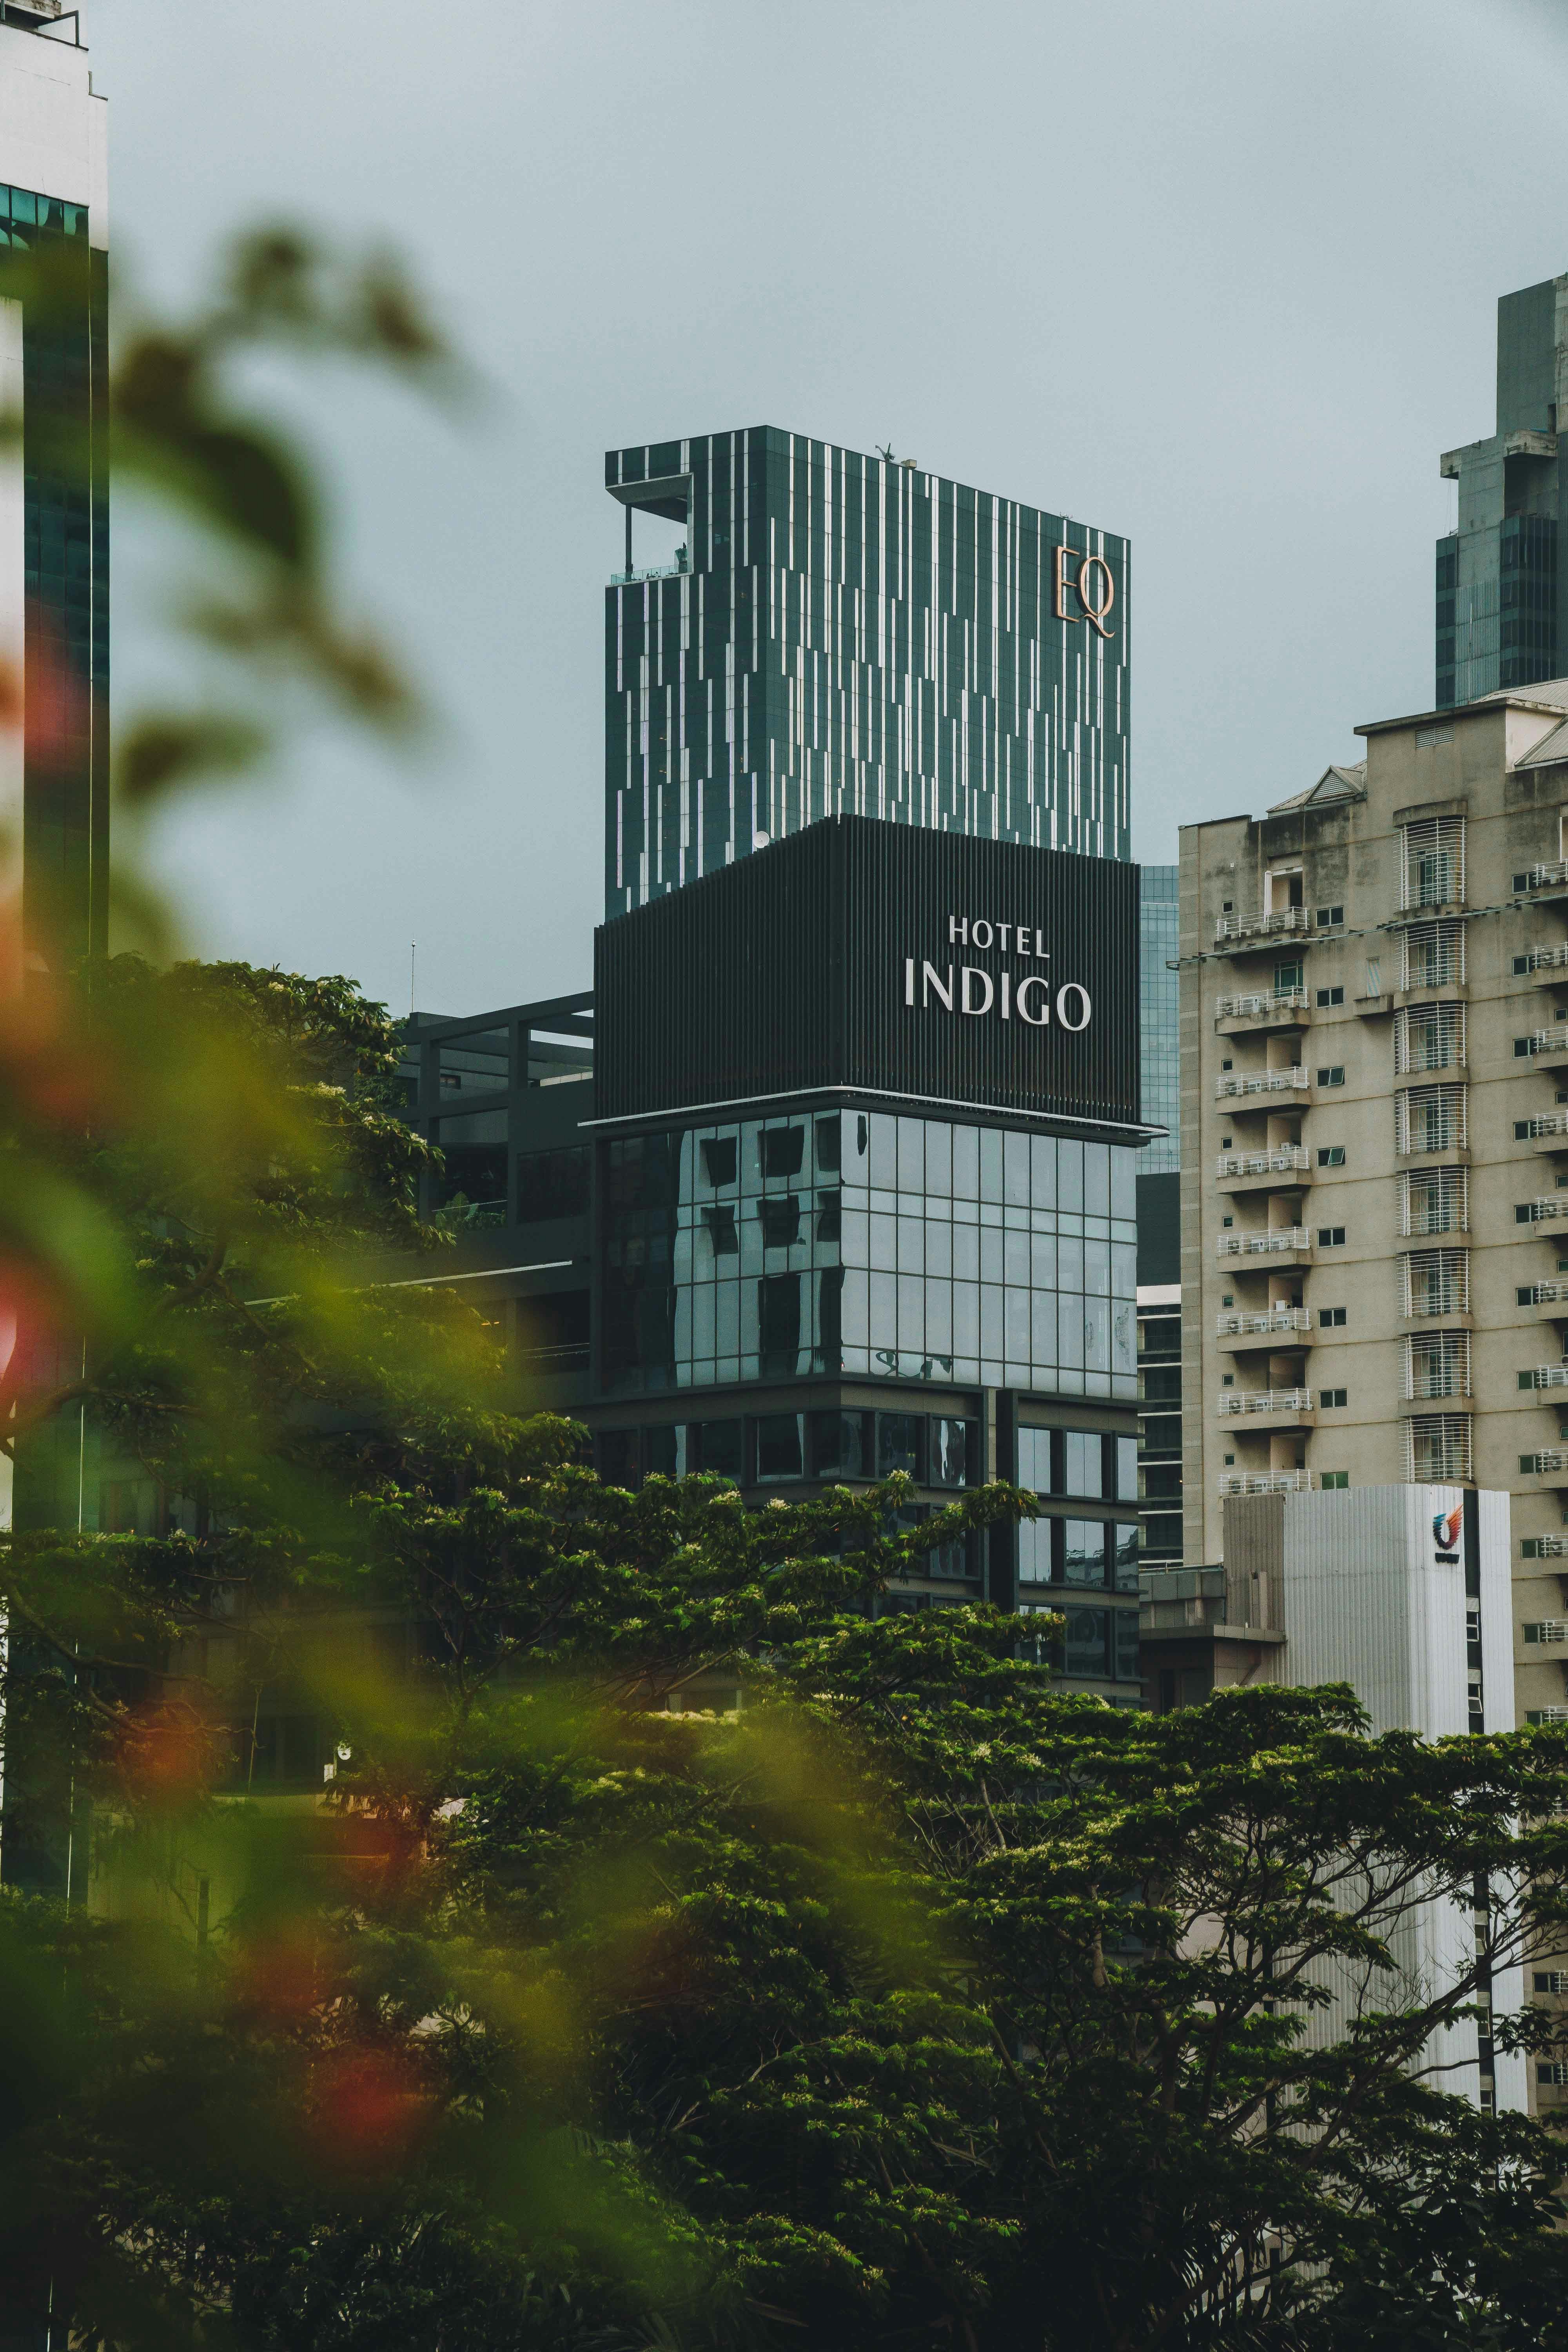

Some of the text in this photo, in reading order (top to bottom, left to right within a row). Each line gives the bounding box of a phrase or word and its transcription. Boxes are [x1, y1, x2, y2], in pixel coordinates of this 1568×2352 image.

[1056, 546, 1116, 638] EQ
[949, 915, 1050, 958] HOTEL
[906, 958, 1091, 1031] INDIGO
